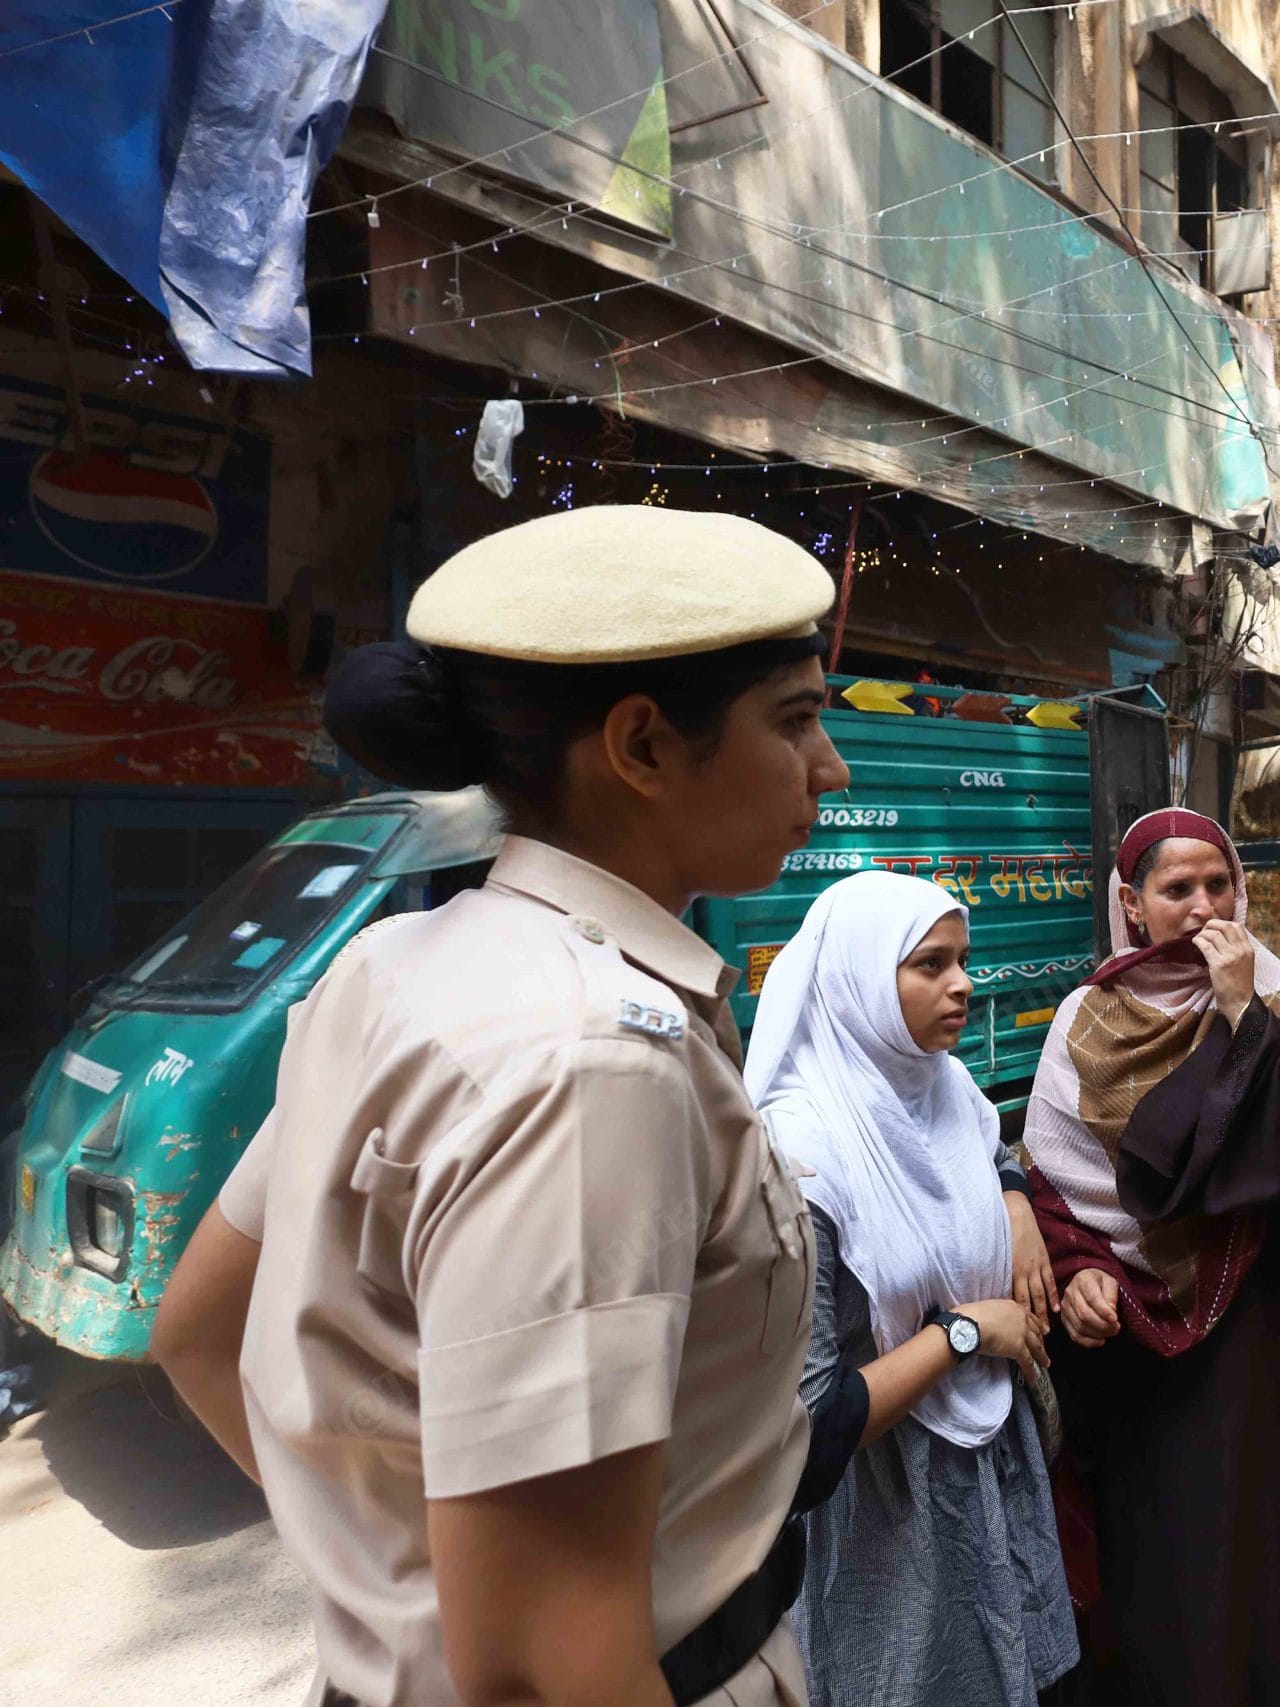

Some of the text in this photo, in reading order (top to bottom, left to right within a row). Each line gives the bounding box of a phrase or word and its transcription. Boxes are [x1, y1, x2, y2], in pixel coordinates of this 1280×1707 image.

[99, 635, 238, 708] Cola
[960, 770, 1005, 787] CNG
[818, 809, 898, 826] 003219
